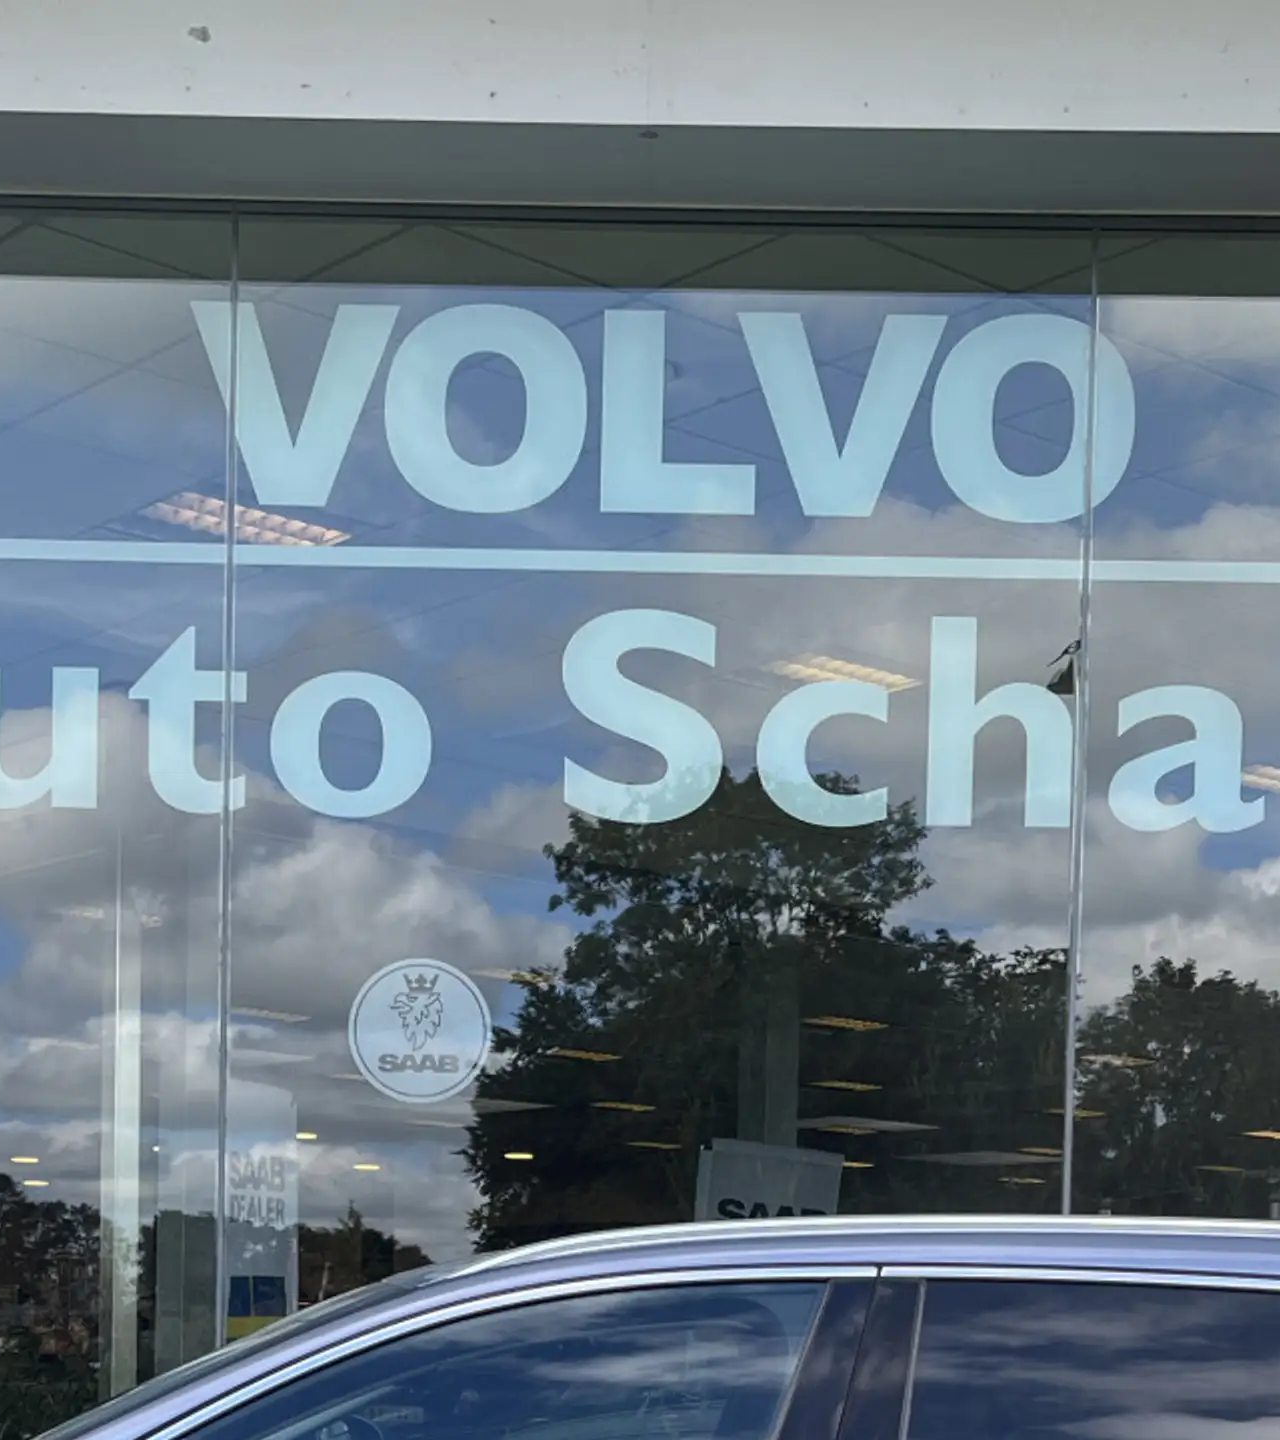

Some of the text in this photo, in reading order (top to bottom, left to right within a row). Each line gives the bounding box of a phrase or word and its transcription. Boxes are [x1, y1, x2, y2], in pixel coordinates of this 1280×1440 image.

[189, 300, 1136, 523] VOLVO
[378, 1054, 459, 1073] SAAB
[229, 1152, 286, 1192] SAAB
[228, 1194, 286, 1226] DEALER
